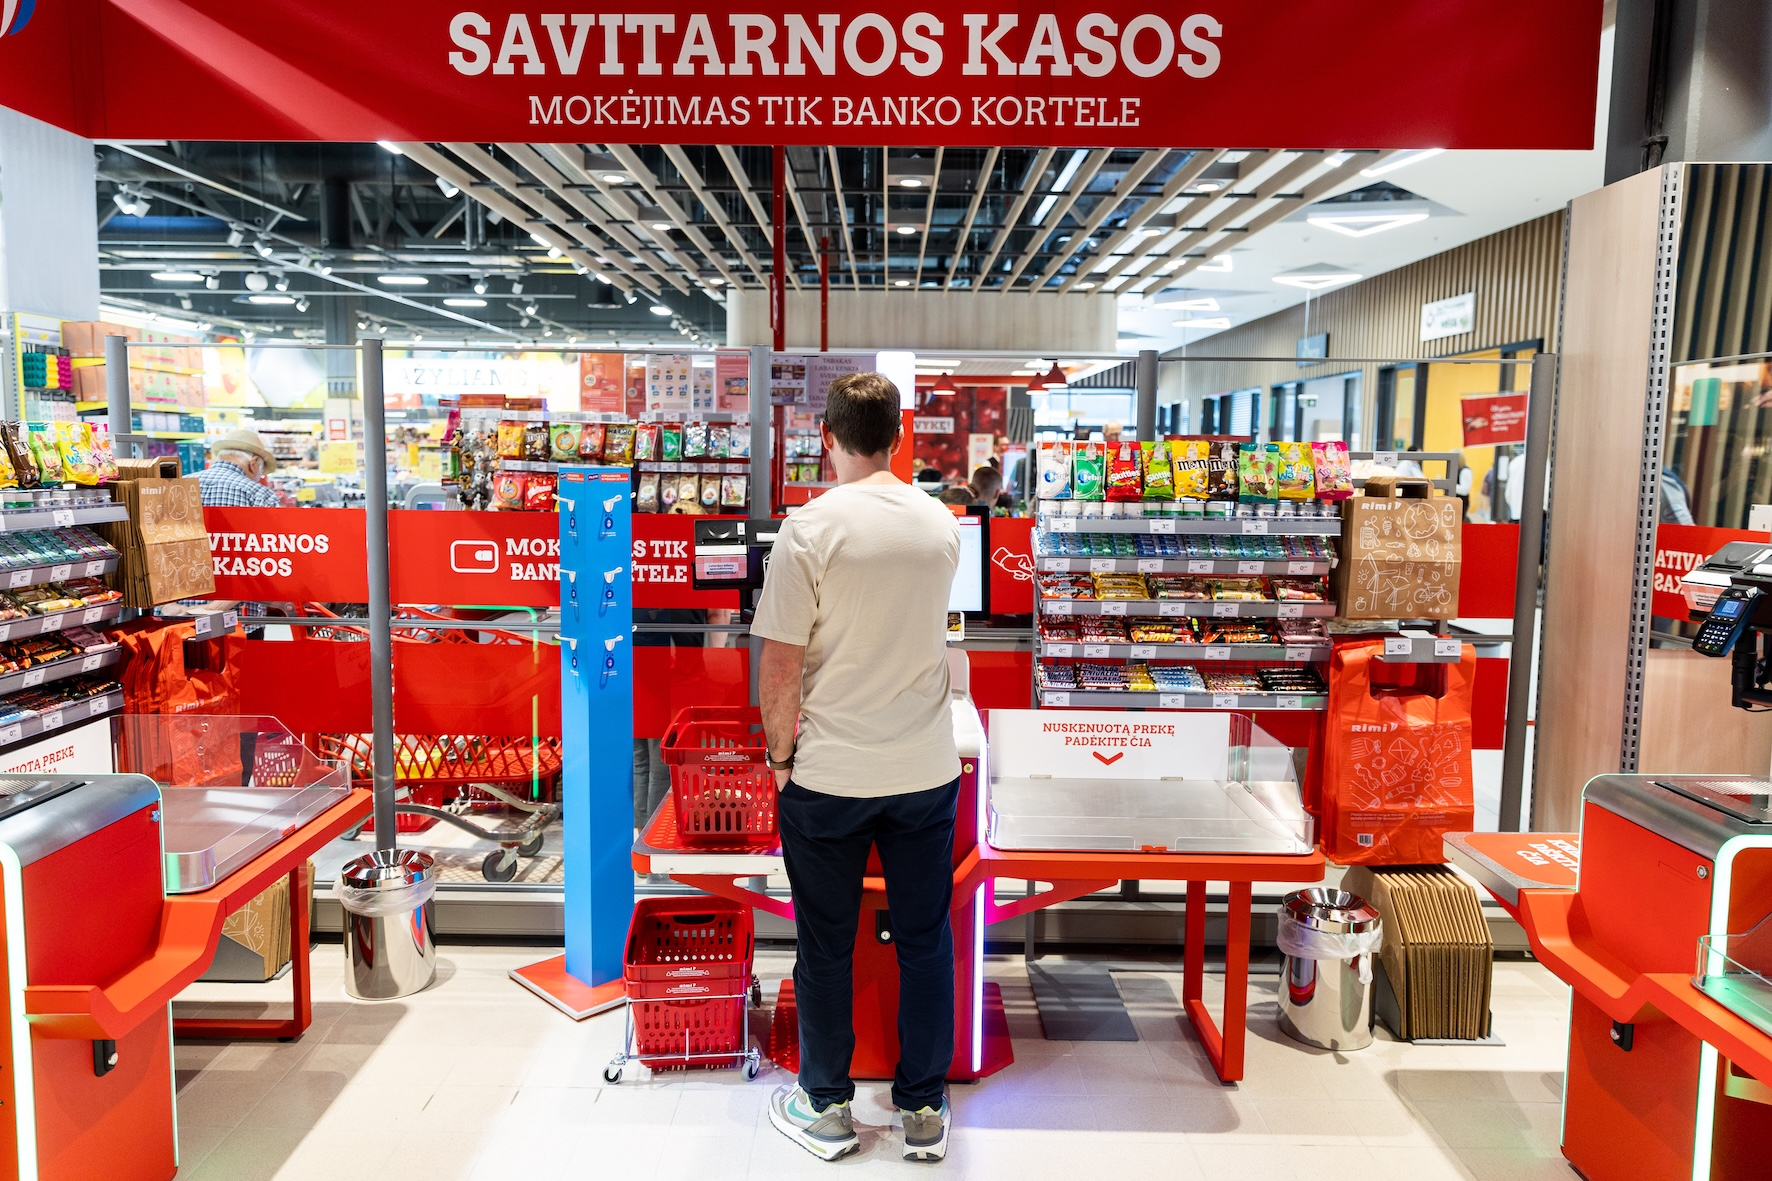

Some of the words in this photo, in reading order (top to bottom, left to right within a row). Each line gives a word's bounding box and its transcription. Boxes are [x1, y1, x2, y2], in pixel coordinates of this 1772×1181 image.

[449, 12, 943, 76] SAVITARNOS
[963, 13, 1222, 78] KASOS
[528, 89, 750, 128] MOKĖJIMAS
[758, 97, 822, 126] TIK
[832, 96, 962, 126] BANKO
[972, 96, 1141, 127] KORTELE
[1361, 502, 1392, 511] Rimi
[650, 541, 688, 558] TIK
[213, 556, 293, 577] KASOS
[1043, 723, 1131, 736] NUSKENUOTĄ
[1133, 725, 1175, 736] PREKĘ
[1351, 723, 1387, 732] Rimi
[1065, 734, 1127, 747] PADĖKITE
[1130, 735, 1152, 747] ČIA
[42, 746, 75, 768] PREKĘ
[1516, 850, 1551, 866] ČIA
